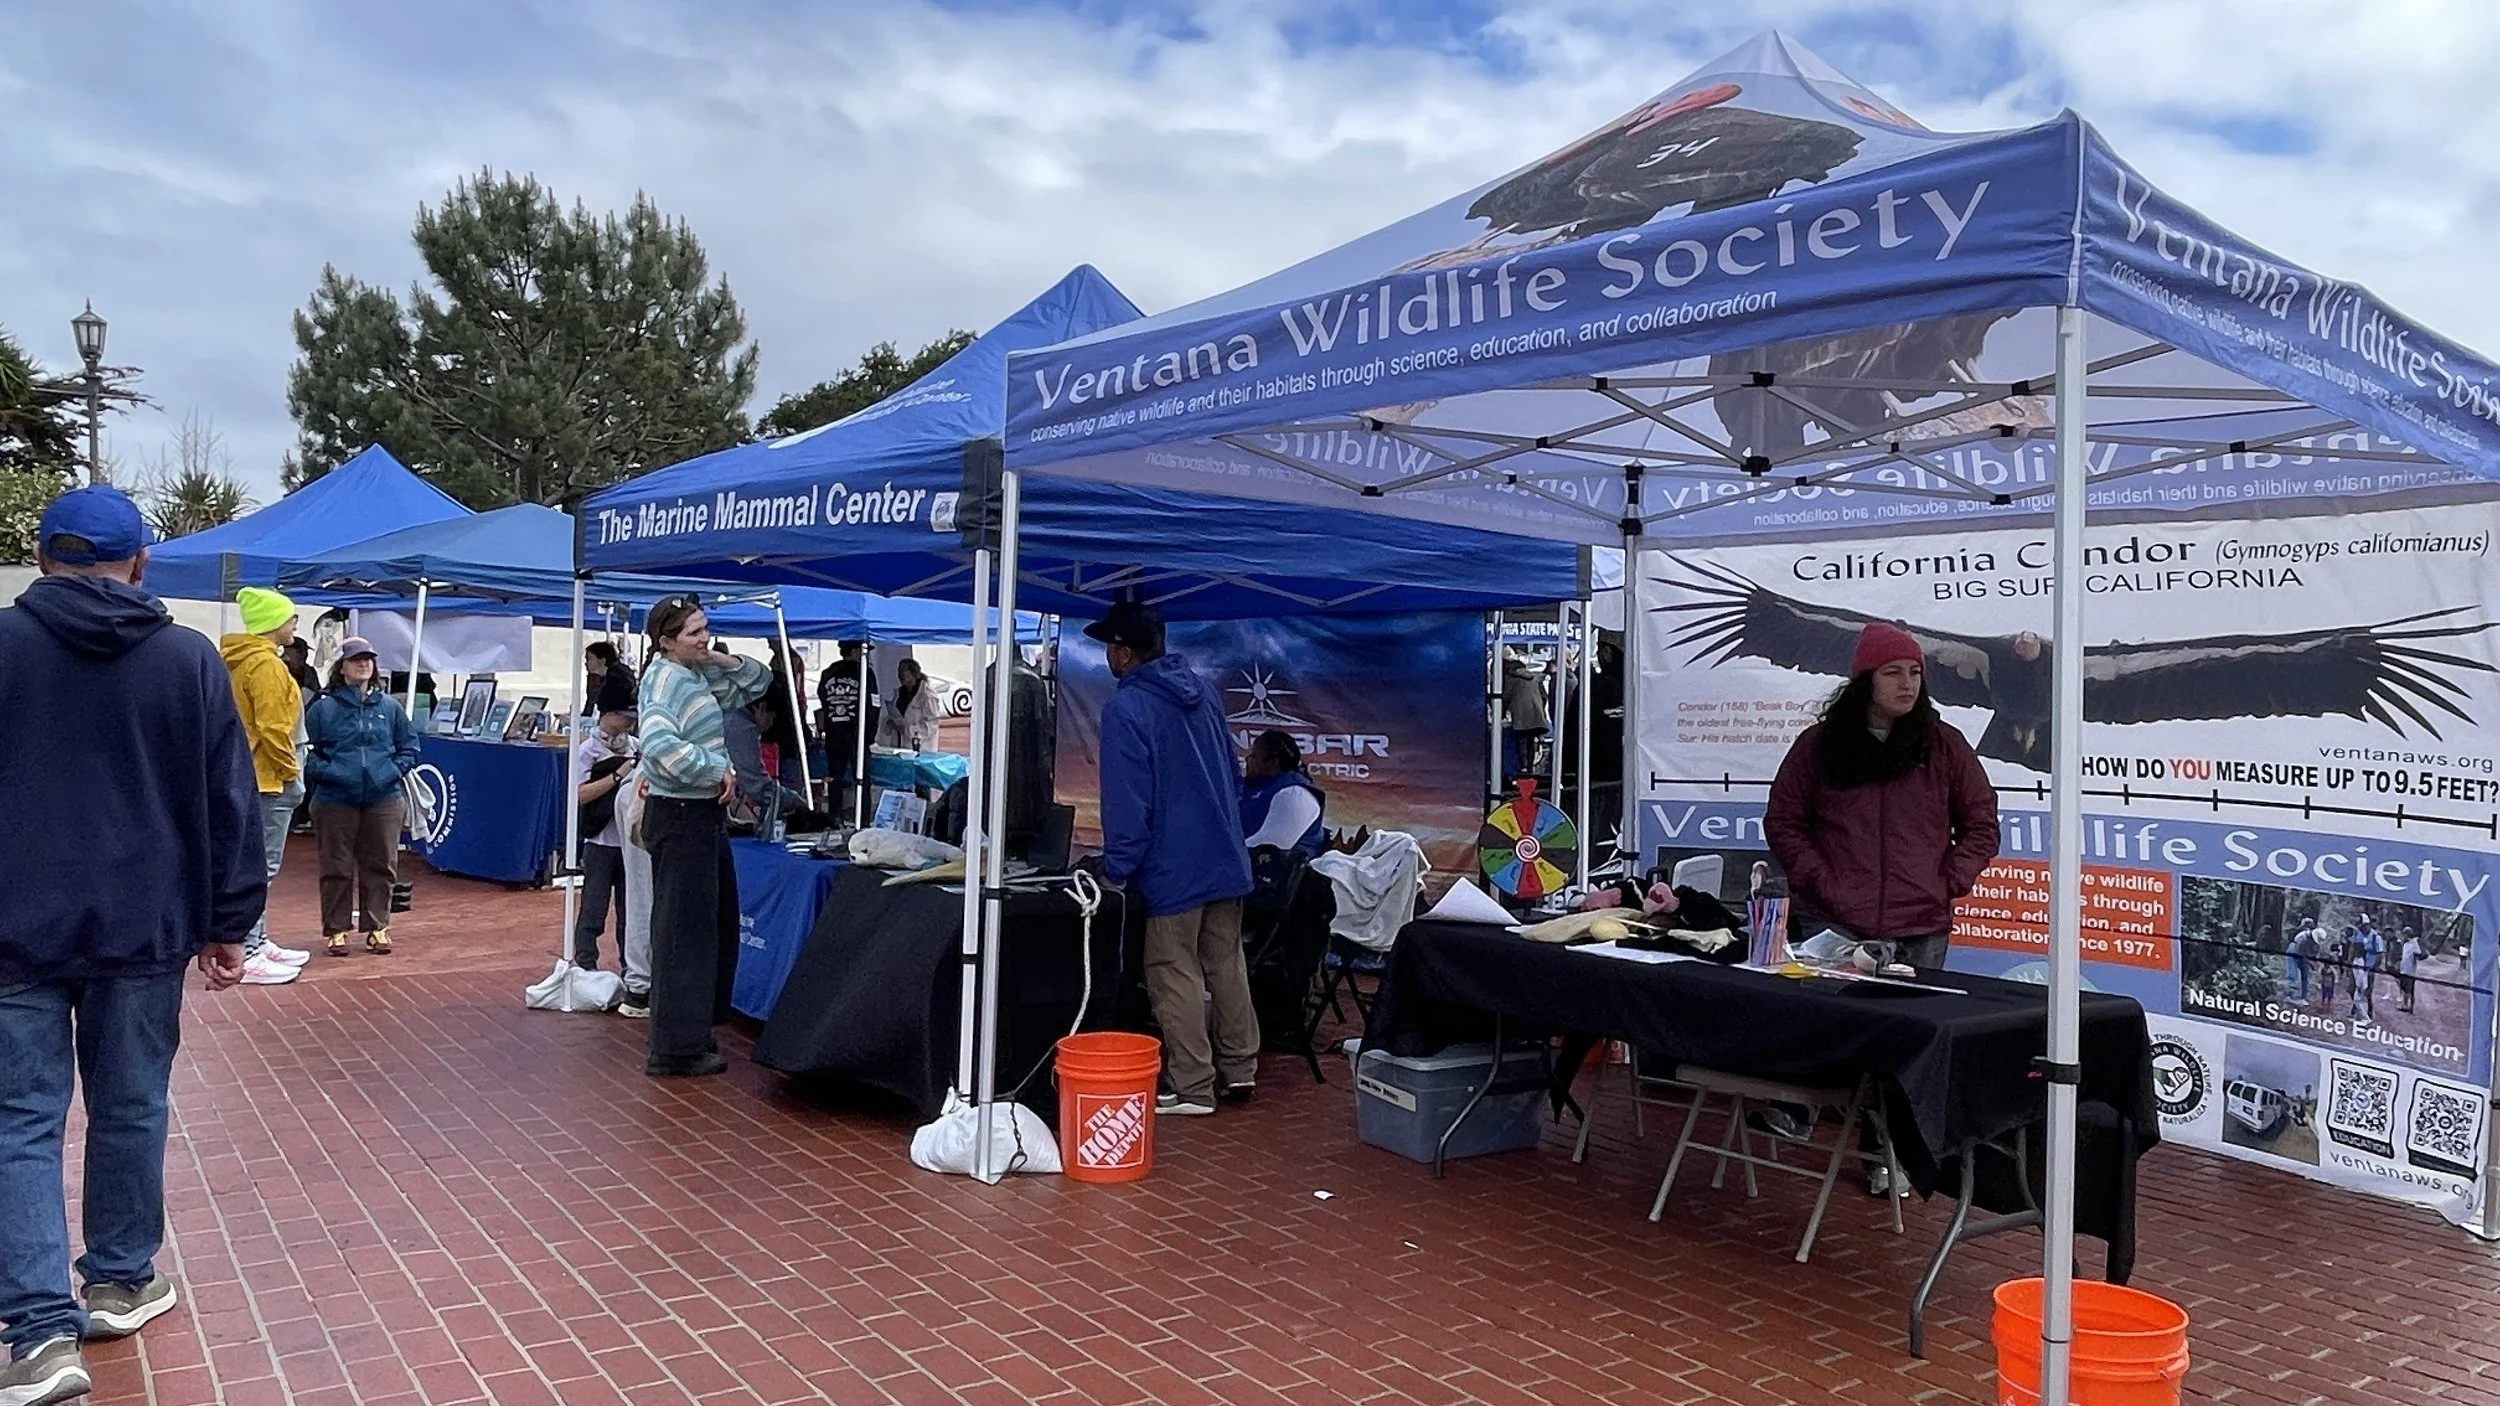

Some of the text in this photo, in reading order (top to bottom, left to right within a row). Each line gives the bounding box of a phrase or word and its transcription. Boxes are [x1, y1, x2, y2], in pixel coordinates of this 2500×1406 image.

[1636, 136, 1720, 169] 34
[1035, 181, 1990, 410] Ventana Wildlife Society
[1031, 288, 1777, 443] conserving native wildlife and their habitats through science, education, and collaboration
[2307, 275, 2427, 388] Wildlife
[2430, 351, 2500, 427] Socie
[599, 481, 926, 545] The Marine Mammal Center
[1793, 548, 1995, 581] California
[2016, 537, 2196, 569] Cndor
[2215, 539, 2340, 564] (Gymnogyps
[1934, 581, 1988, 600] BIG
[2085, 568, 2304, 593] CALIFORNIA
[1520, 623, 1546, 636] STATE
[1547, 623, 1574, 636] PAS
[1307, 762, 1370, 779] CTRIC
[2081, 756, 2499, 804] HOW DO YOU MEASURE UP TO 9.5 FEET?
[2319, 747, 2493, 773] ventanaws.org
[1980, 865, 2036, 884] erving
[2099, 872, 2164, 894] wildlife
[1998, 814, 2490, 912] illife Society
[1954, 904, 2016, 922] cience,
[2119, 921, 2154, 935] and
[1972, 883, 2164, 918] their habs through
[1951, 923, 2161, 959] ollaboratio nce 1977.
[2189, 989, 2462, 1062] Natural Science Education
[2154, 1034, 2198, 1055] THROUGH
[2197, 1055, 2213, 1095] NATURE
[1084, 1103, 1116, 1132] THE
[2157, 1101, 2190, 1114] CIETY
[1079, 1095, 1145, 1166] HOME
[1104, 1120, 1145, 1166] DEPOT
[2329, 1150, 2474, 1210] ventanaws.org
